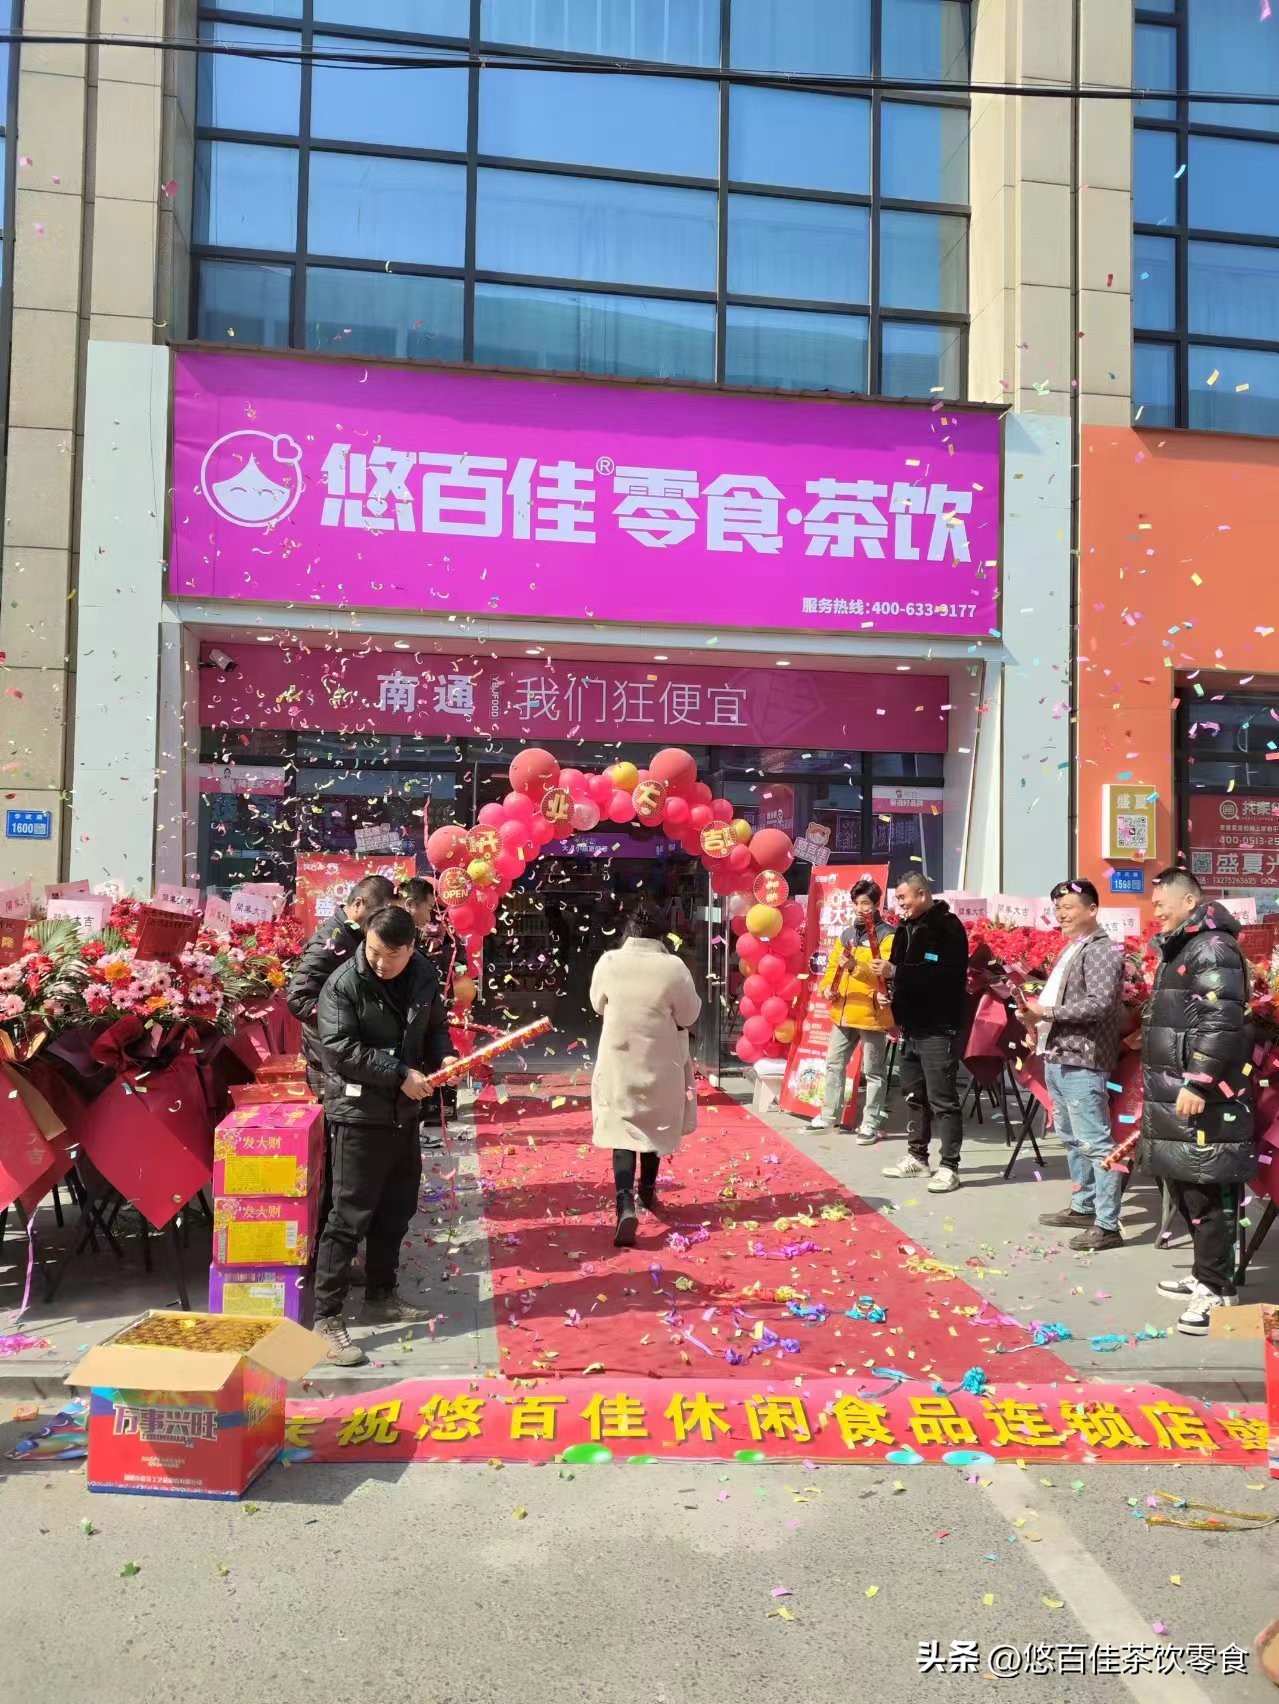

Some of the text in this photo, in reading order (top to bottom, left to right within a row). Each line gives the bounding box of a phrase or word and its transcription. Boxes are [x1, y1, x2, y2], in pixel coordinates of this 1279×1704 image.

[377, 671, 475, 715] 南通
[513, 676, 748, 726] 我们狂便宜
[546, 794, 569, 820] 业
[12, 822, 33, 833] 1600
[1115, 879, 1131, 889] 1598
[442, 887, 469, 899] OPEN
[243, 1135, 282, 1151] 发大财
[243, 1204, 282, 1219] 发大财
